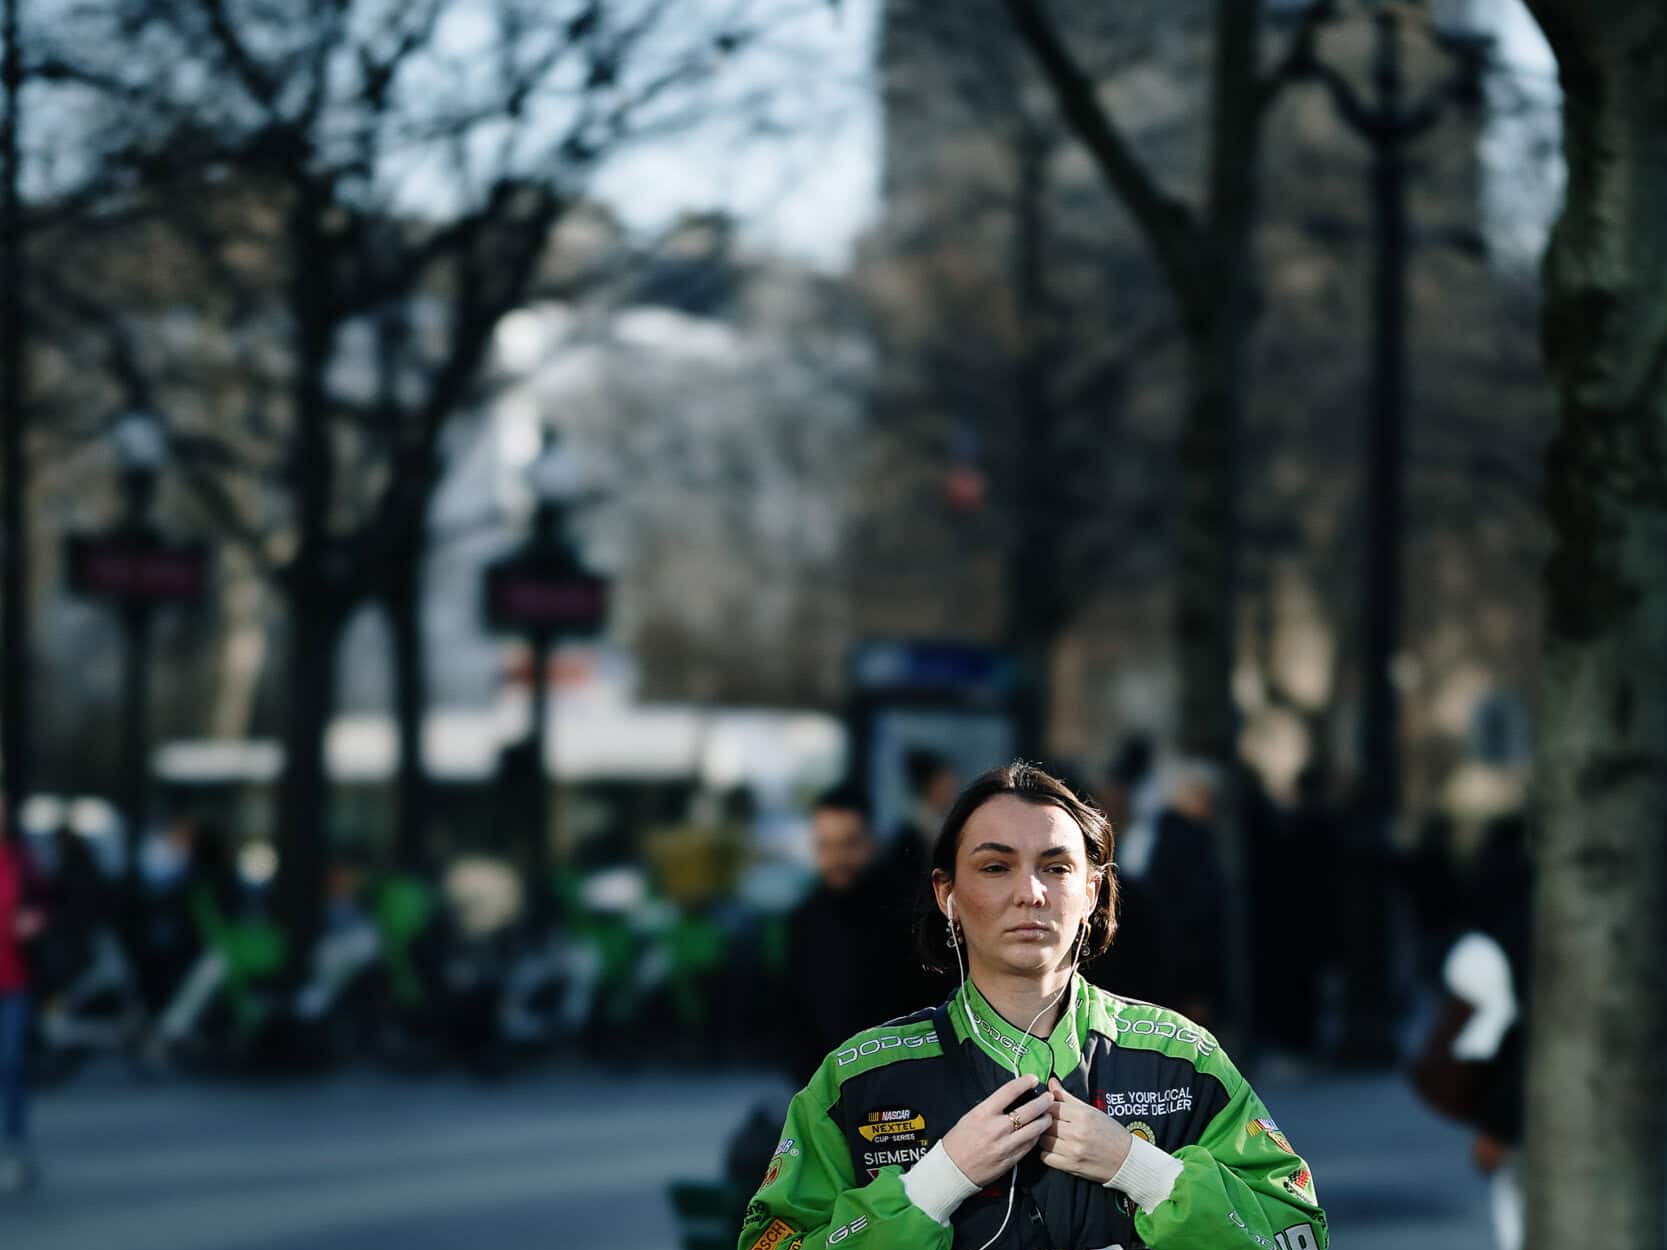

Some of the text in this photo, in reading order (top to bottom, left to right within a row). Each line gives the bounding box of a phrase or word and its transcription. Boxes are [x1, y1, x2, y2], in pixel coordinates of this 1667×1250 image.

[1113, 1015, 1218, 1057] DODGE
[837, 1030, 940, 1066] DODGE
[1105, 1086, 1193, 1105] SEE YOUR LOCAL
[881, 1109, 911, 1121] NASCAR
[1107, 1102, 1149, 1117] DODGE
[871, 1121, 916, 1134] NEXTEL
[874, 1133, 916, 1143] CUP SERIES
[863, 1147, 927, 1165] SIEMENS
